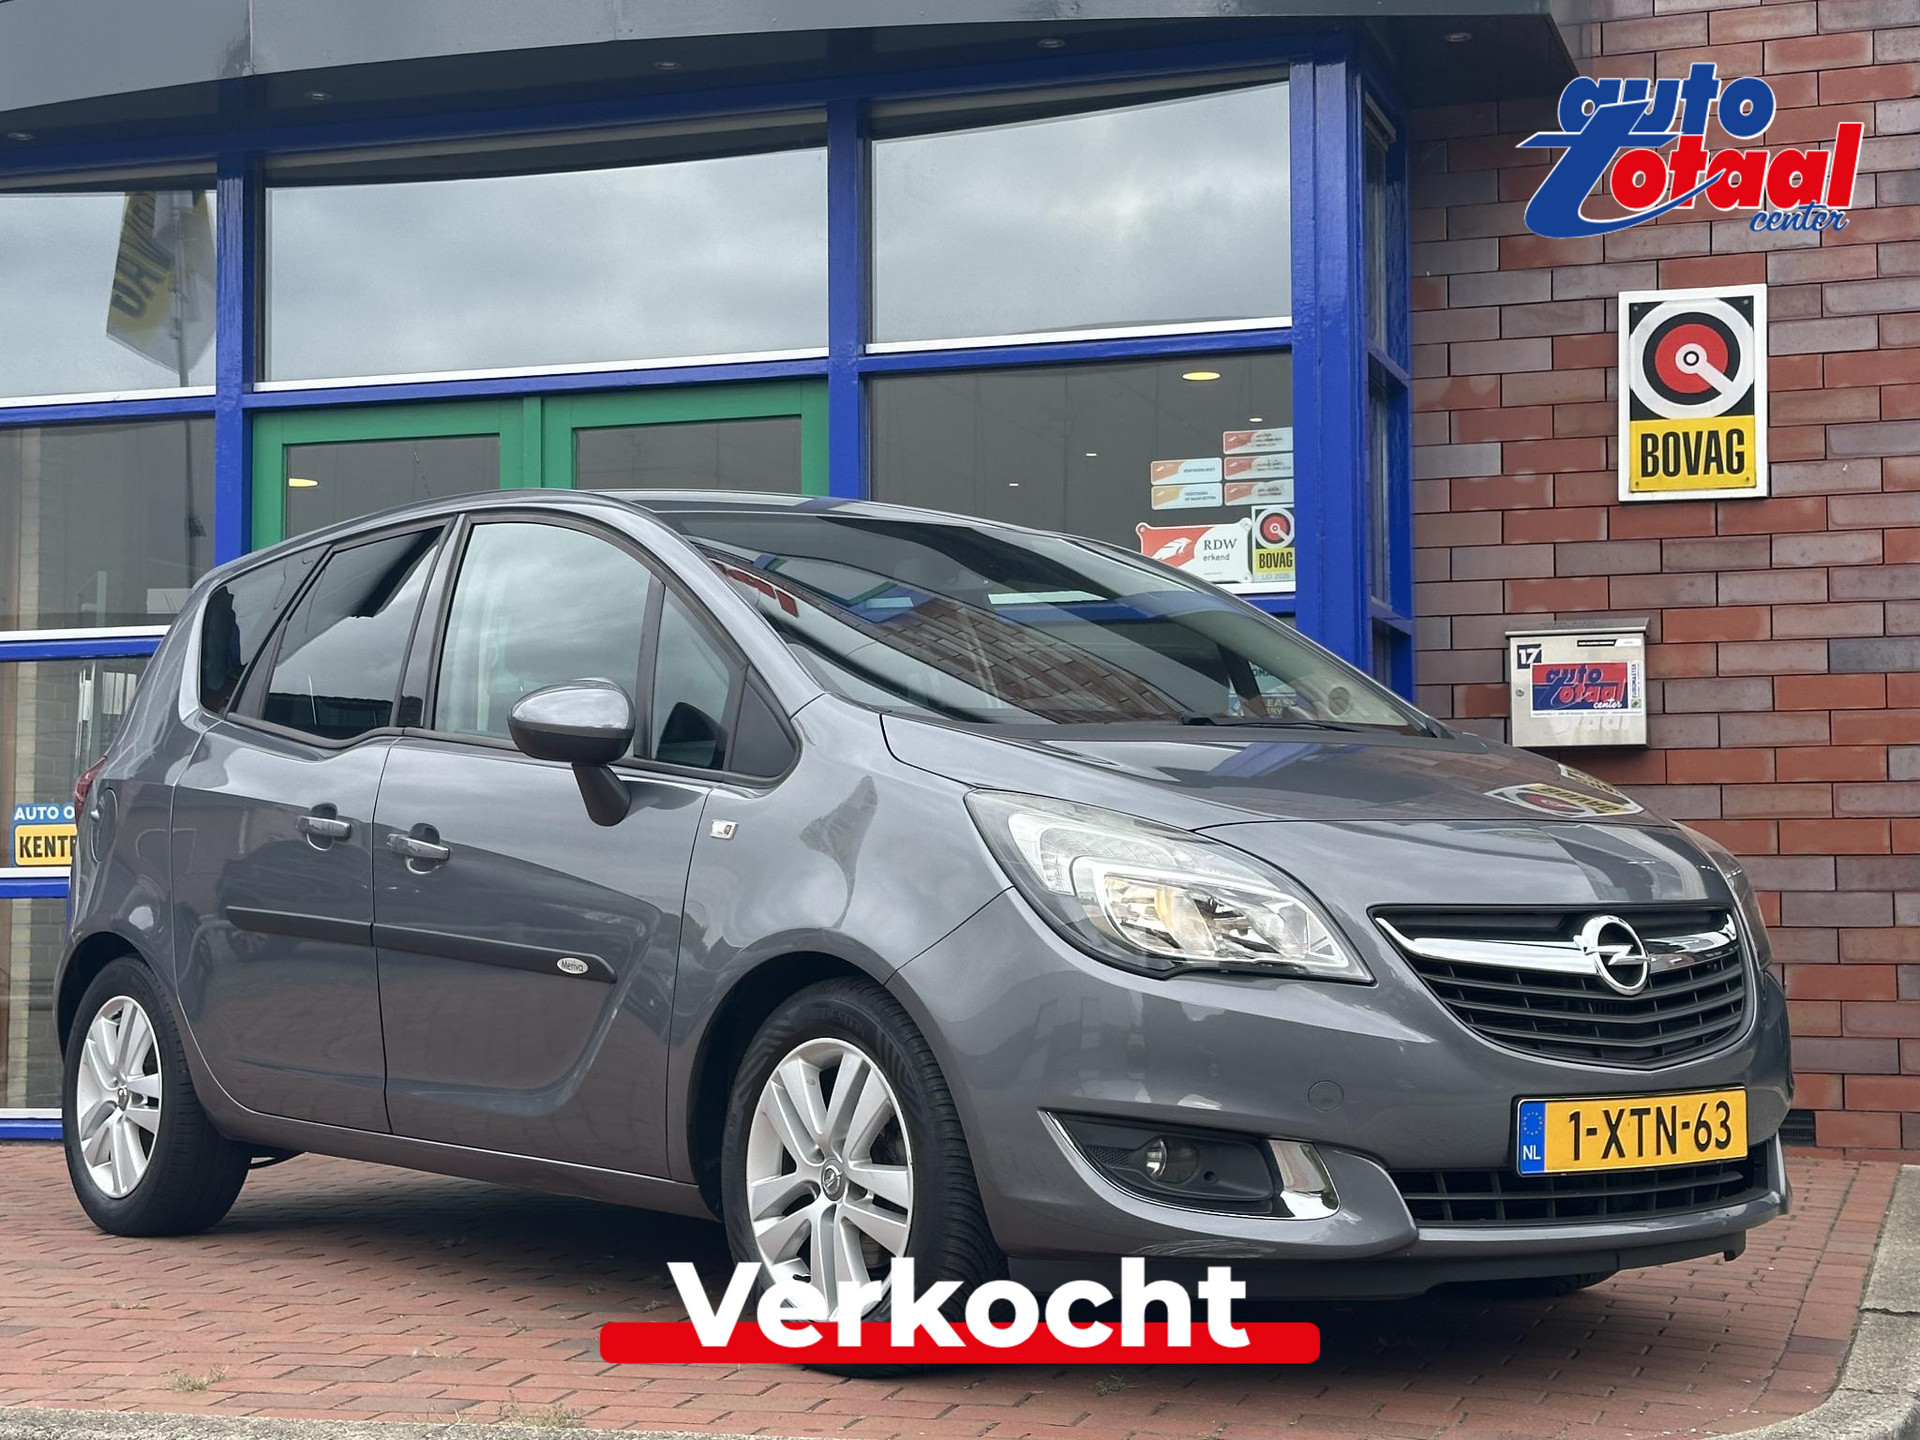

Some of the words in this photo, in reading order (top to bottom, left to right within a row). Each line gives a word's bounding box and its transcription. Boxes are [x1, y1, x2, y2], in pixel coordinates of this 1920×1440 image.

[1640, 428, 1745, 478] BOVAG
[1203, 538, 1238, 551] RDW
[1203, 553, 1230, 562] erkend
[1259, 551, 1293, 569] BOVAG
[1518, 647, 1542, 665] 17
[1593, 698, 1623, 709] center
[14, 806, 60, 820] AUTO
[1569, 1100, 1732, 1161] 1-XTN-63
[1522, 1145, 1541, 1161] NL
